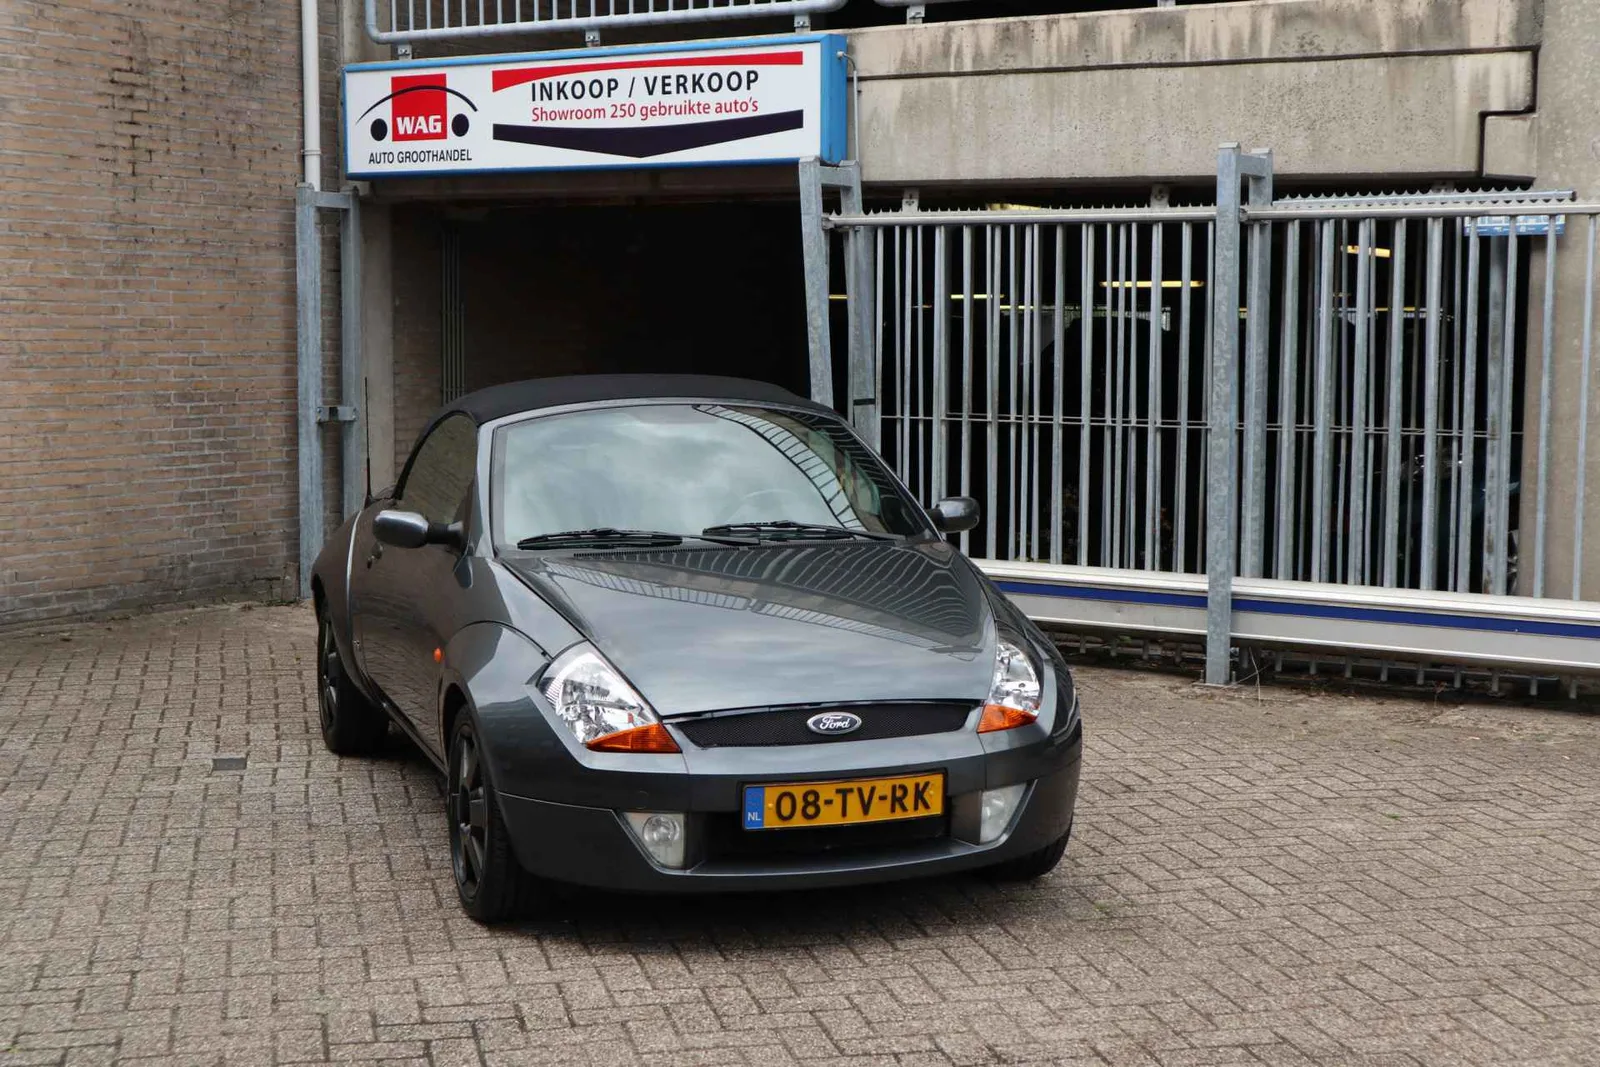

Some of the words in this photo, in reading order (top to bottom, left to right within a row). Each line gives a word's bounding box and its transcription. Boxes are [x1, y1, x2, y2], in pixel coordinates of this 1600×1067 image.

[531, 78, 619, 102] INKOOP
[628, 77, 636, 98] /
[644, 70, 760, 97] VERKOOP
[532, 103, 606, 122] Showroom
[610, 103, 636, 119] 250
[640, 98, 711, 121] gebruikte
[715, 97, 759, 114] auto's
[396, 115, 442, 135] WAG
[368, 151, 394, 165] AUTO
[397, 149, 472, 164] GROOTHANDEL
[819, 715, 850, 730] Ford
[747, 811, 761, 821] NL
[775, 780, 931, 822] 08-TV-RK
